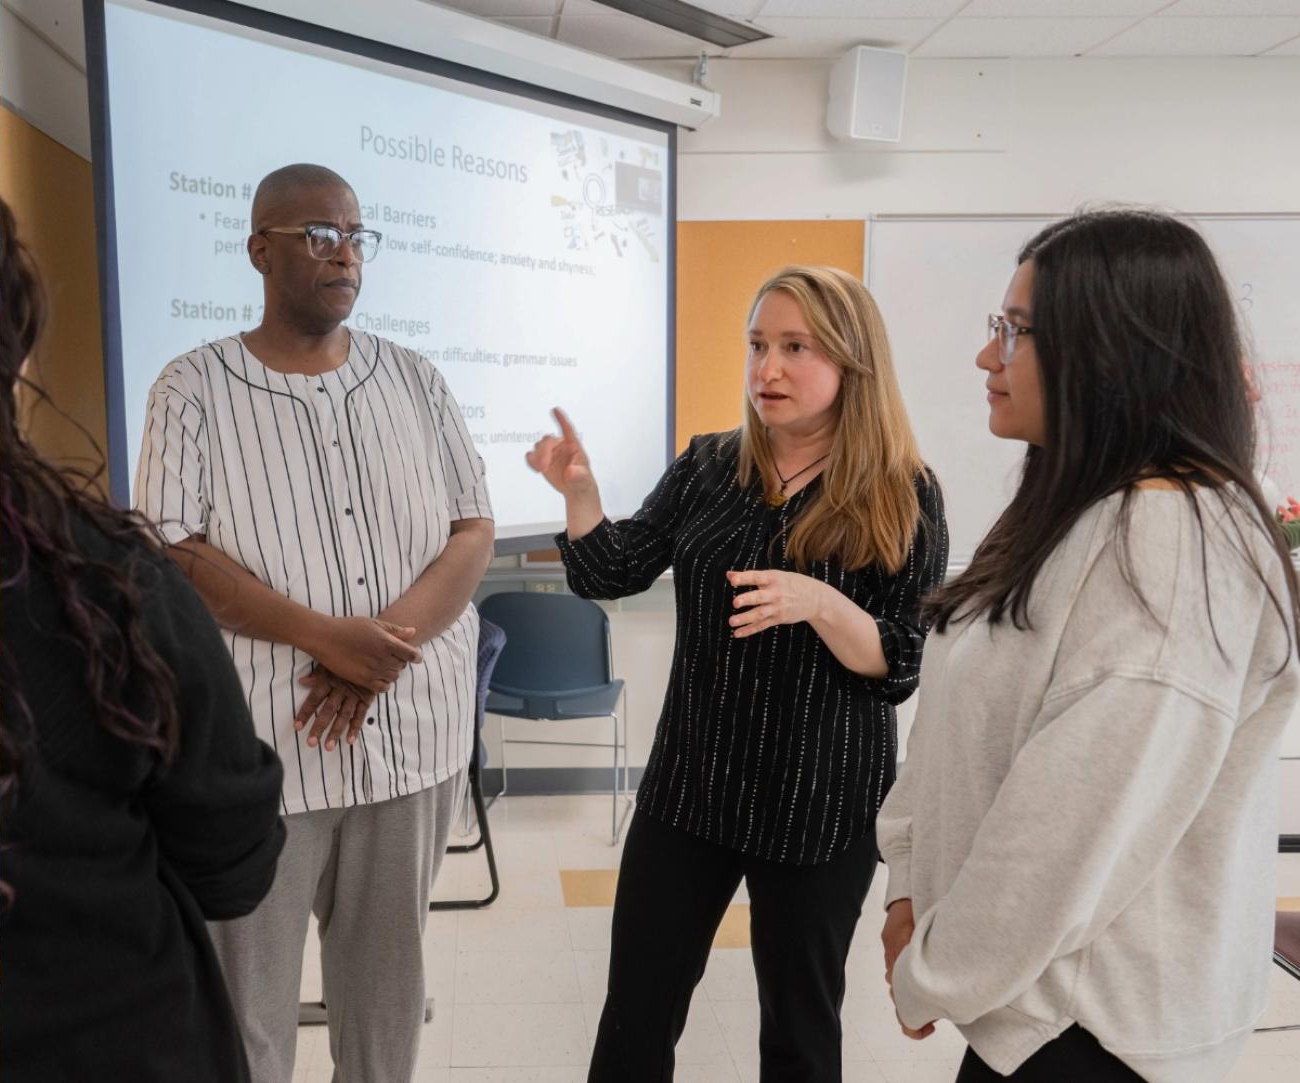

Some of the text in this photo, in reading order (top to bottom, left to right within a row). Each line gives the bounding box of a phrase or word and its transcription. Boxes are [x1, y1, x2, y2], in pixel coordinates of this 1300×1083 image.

[360, 125, 528, 184] Possible Reasons
[169, 171, 236, 199] Station
[214, 211, 248, 230] Fear
[384, 205, 436, 229] Barriers
[214, 237, 247, 256] perf
[385, 235, 407, 251] low
[411, 239, 498, 266] self-confidence;
[500, 252, 536, 271] anxiety
[538, 256, 556, 271] and
[170, 298, 237, 321] Station
[241, 303, 252, 321] #
[356, 312, 431, 337] Challenges
[503, 353, 547, 367] grammar
[549, 353, 578, 367] issues
